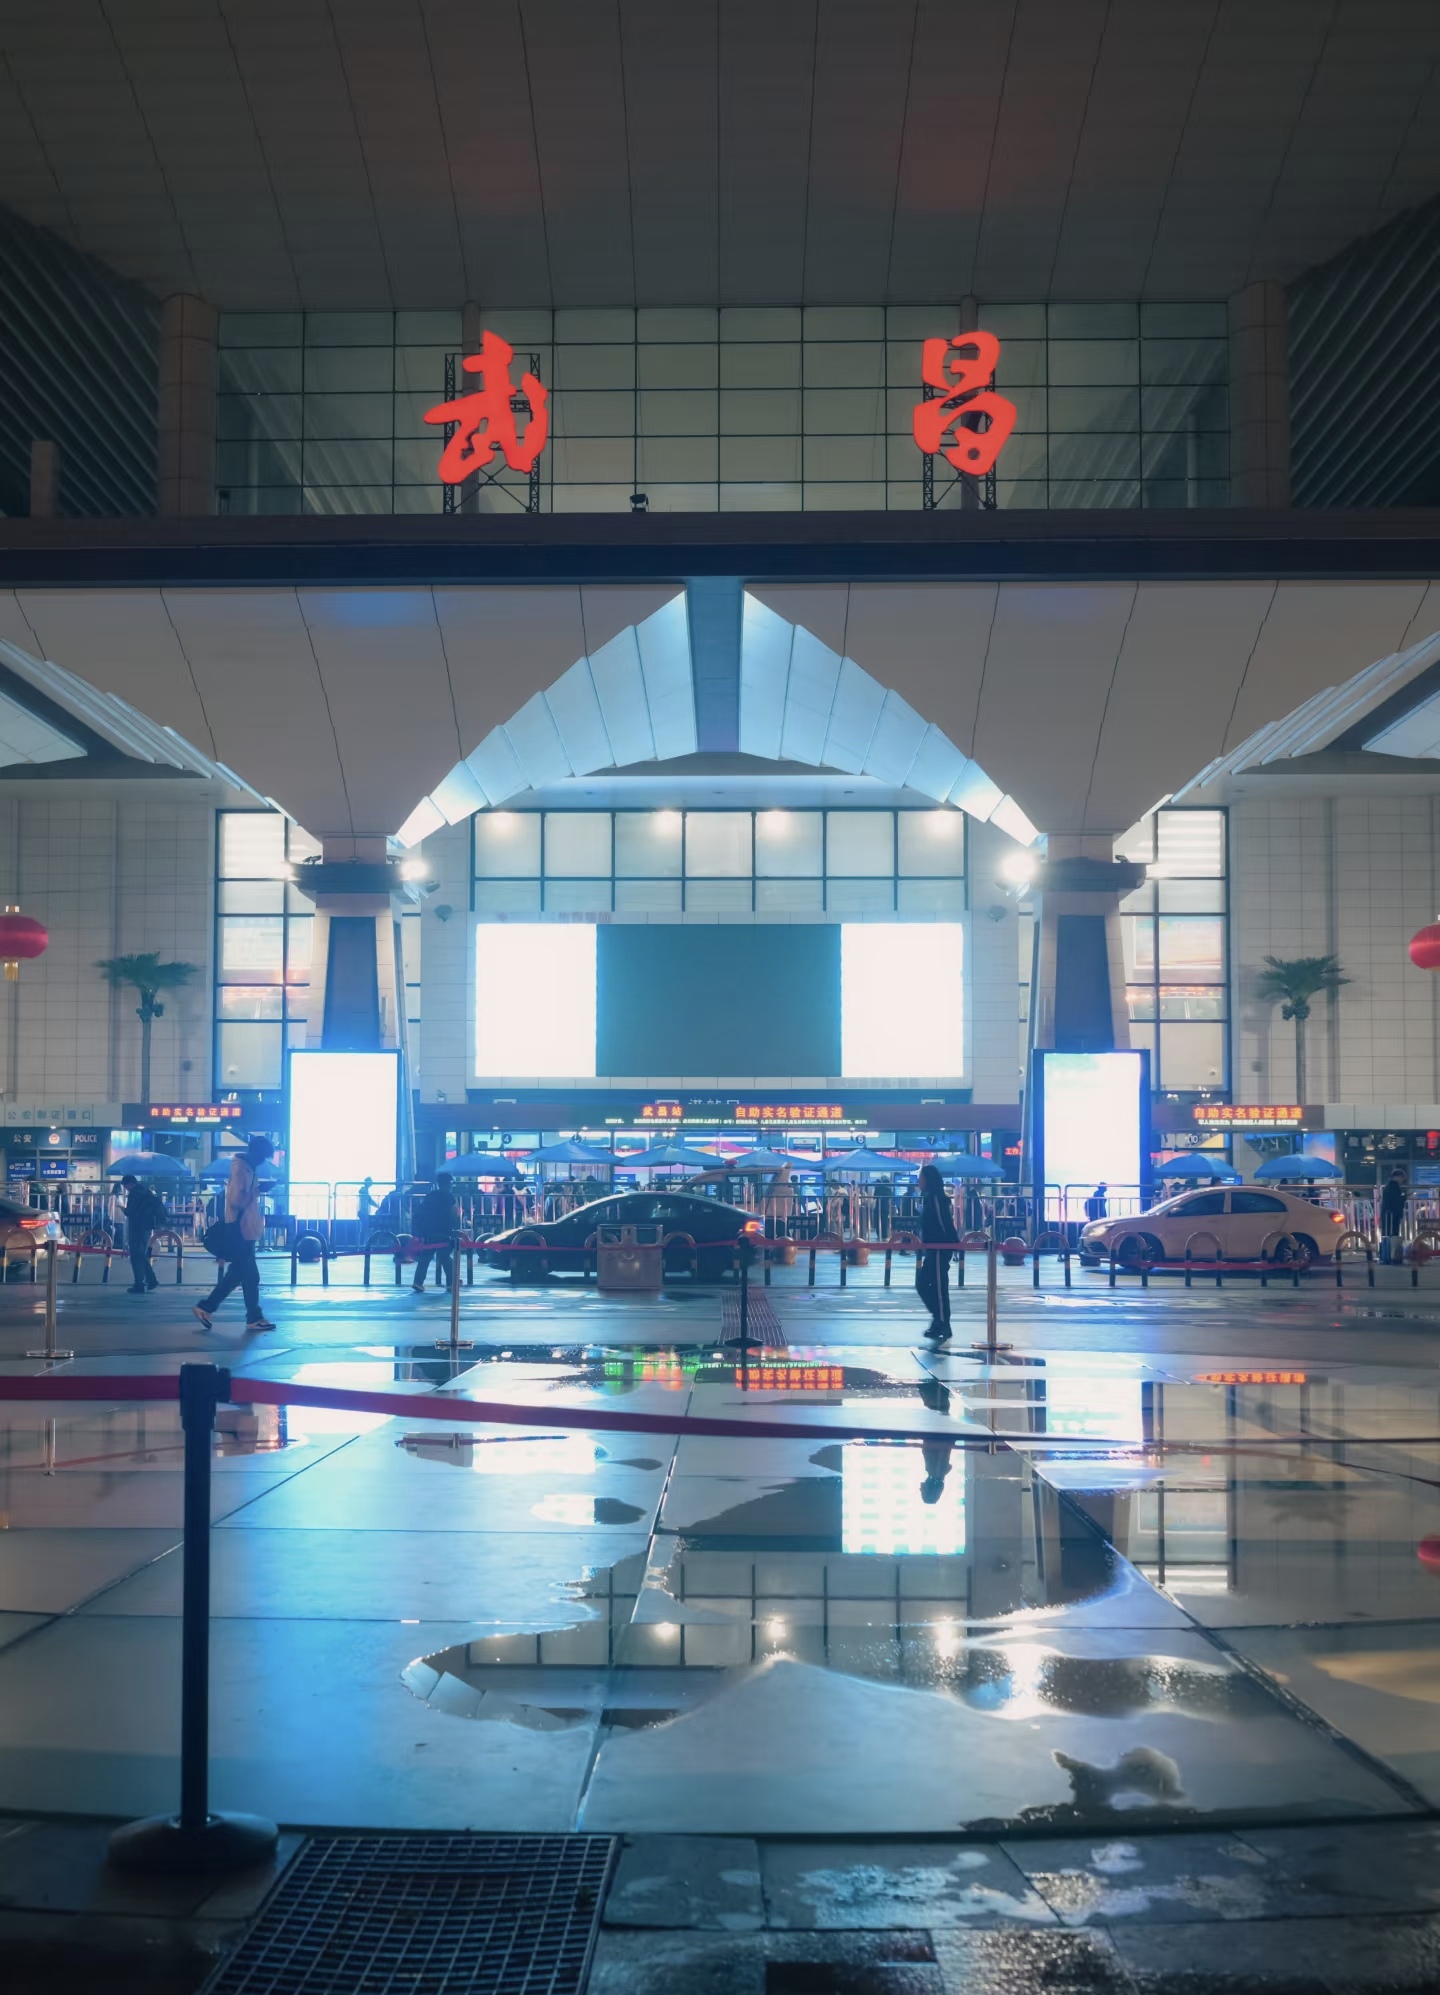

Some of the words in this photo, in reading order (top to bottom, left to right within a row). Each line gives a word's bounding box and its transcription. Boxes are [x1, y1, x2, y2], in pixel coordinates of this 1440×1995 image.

[642, 1105, 683, 1117] 武昌站
[735, 1106, 843, 1118] 自助实名验证通道
[1194, 1107, 1303, 1119] 自助实名验证通道
[13, 1134, 32, 1143] 公安
[75, 1134, 97, 1143] POLICE
